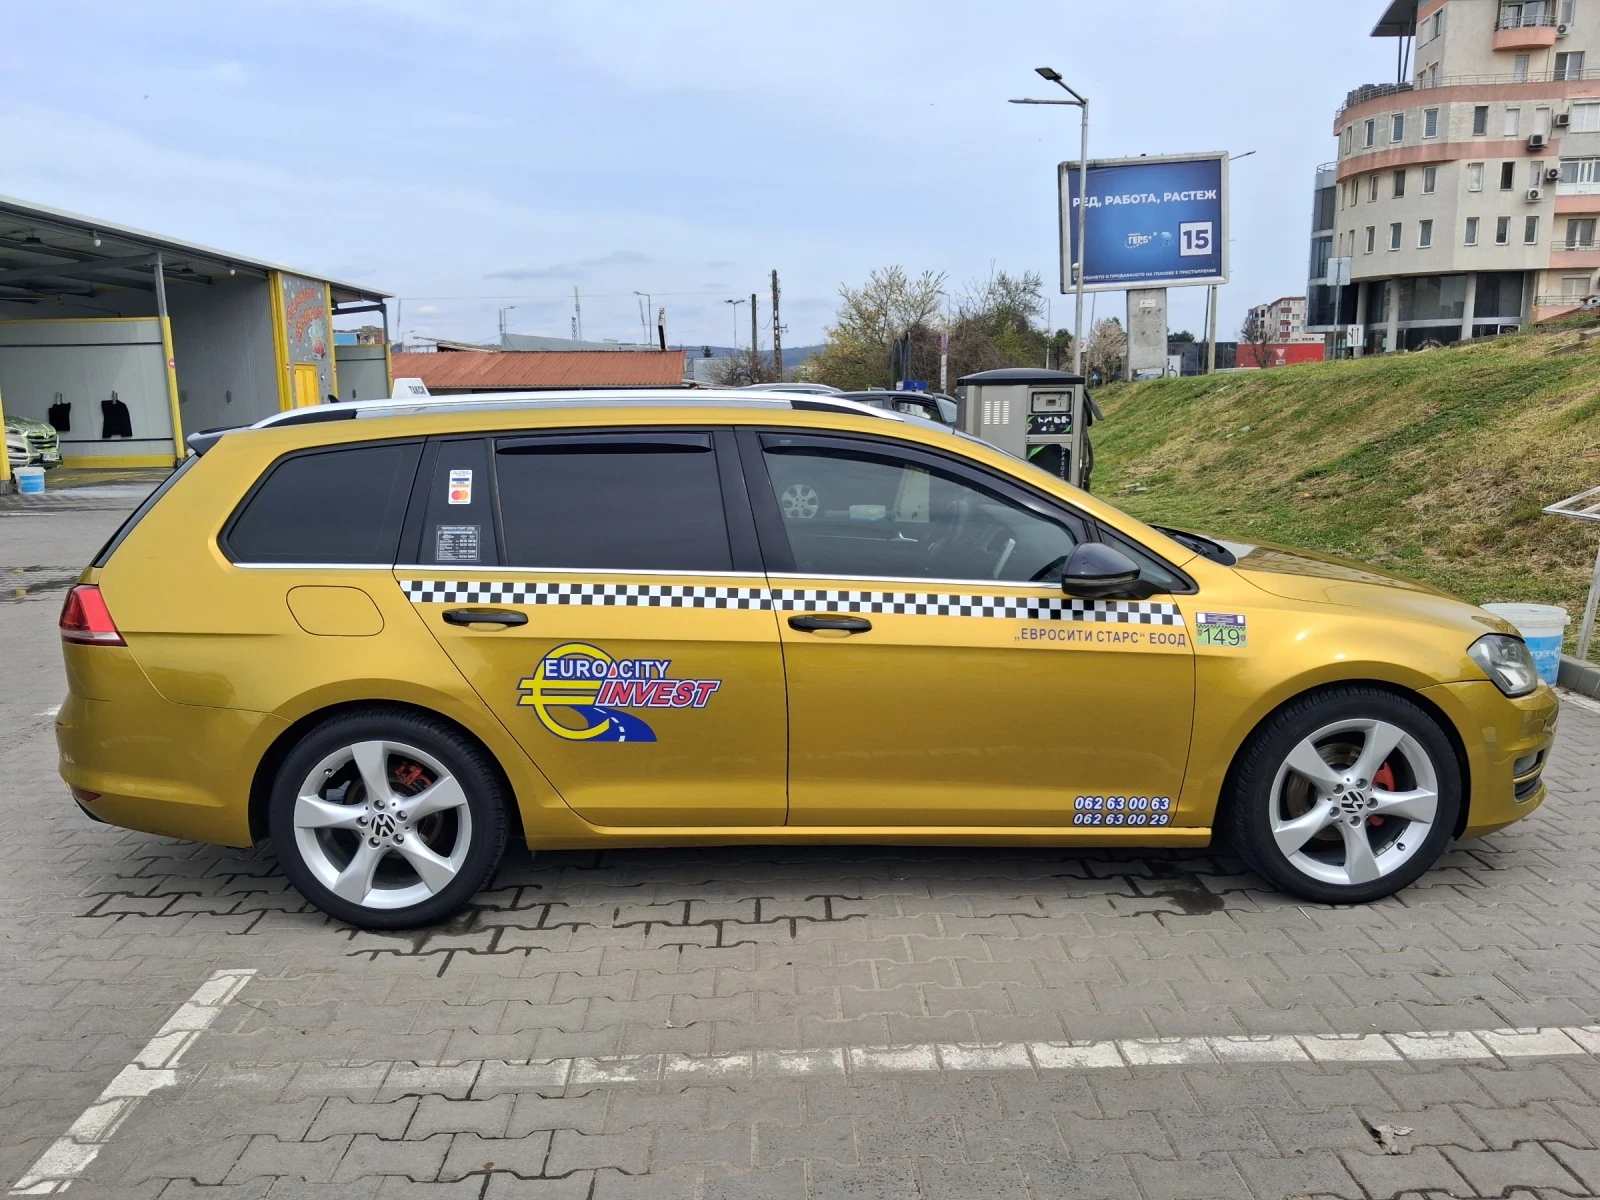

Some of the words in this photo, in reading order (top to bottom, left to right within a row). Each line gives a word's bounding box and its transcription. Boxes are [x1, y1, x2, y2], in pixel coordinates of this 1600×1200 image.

[1105, 193, 1160, 205] РАБОТА,
[1164, 189, 1217, 202] РАСТЕЖ
[1183, 229, 1210, 250] 15
[1149, 633, 1187, 647] ЕООД
[1203, 627, 1240, 646] 149
[543, 658, 609, 679] EURO
[618, 659, 671, 680] CITY
[595, 679, 722, 708] INVEST
[1074, 796, 1104, 810] 062
[1106, 796, 1126, 810] 63
[1128, 796, 1148, 811] 00
[1150, 796, 1171, 811] 63
[1073, 813, 1103, 825] 062
[1105, 813, 1125, 825] 63
[1127, 813, 1147, 825] 00
[1149, 813, 1169, 826] 29
